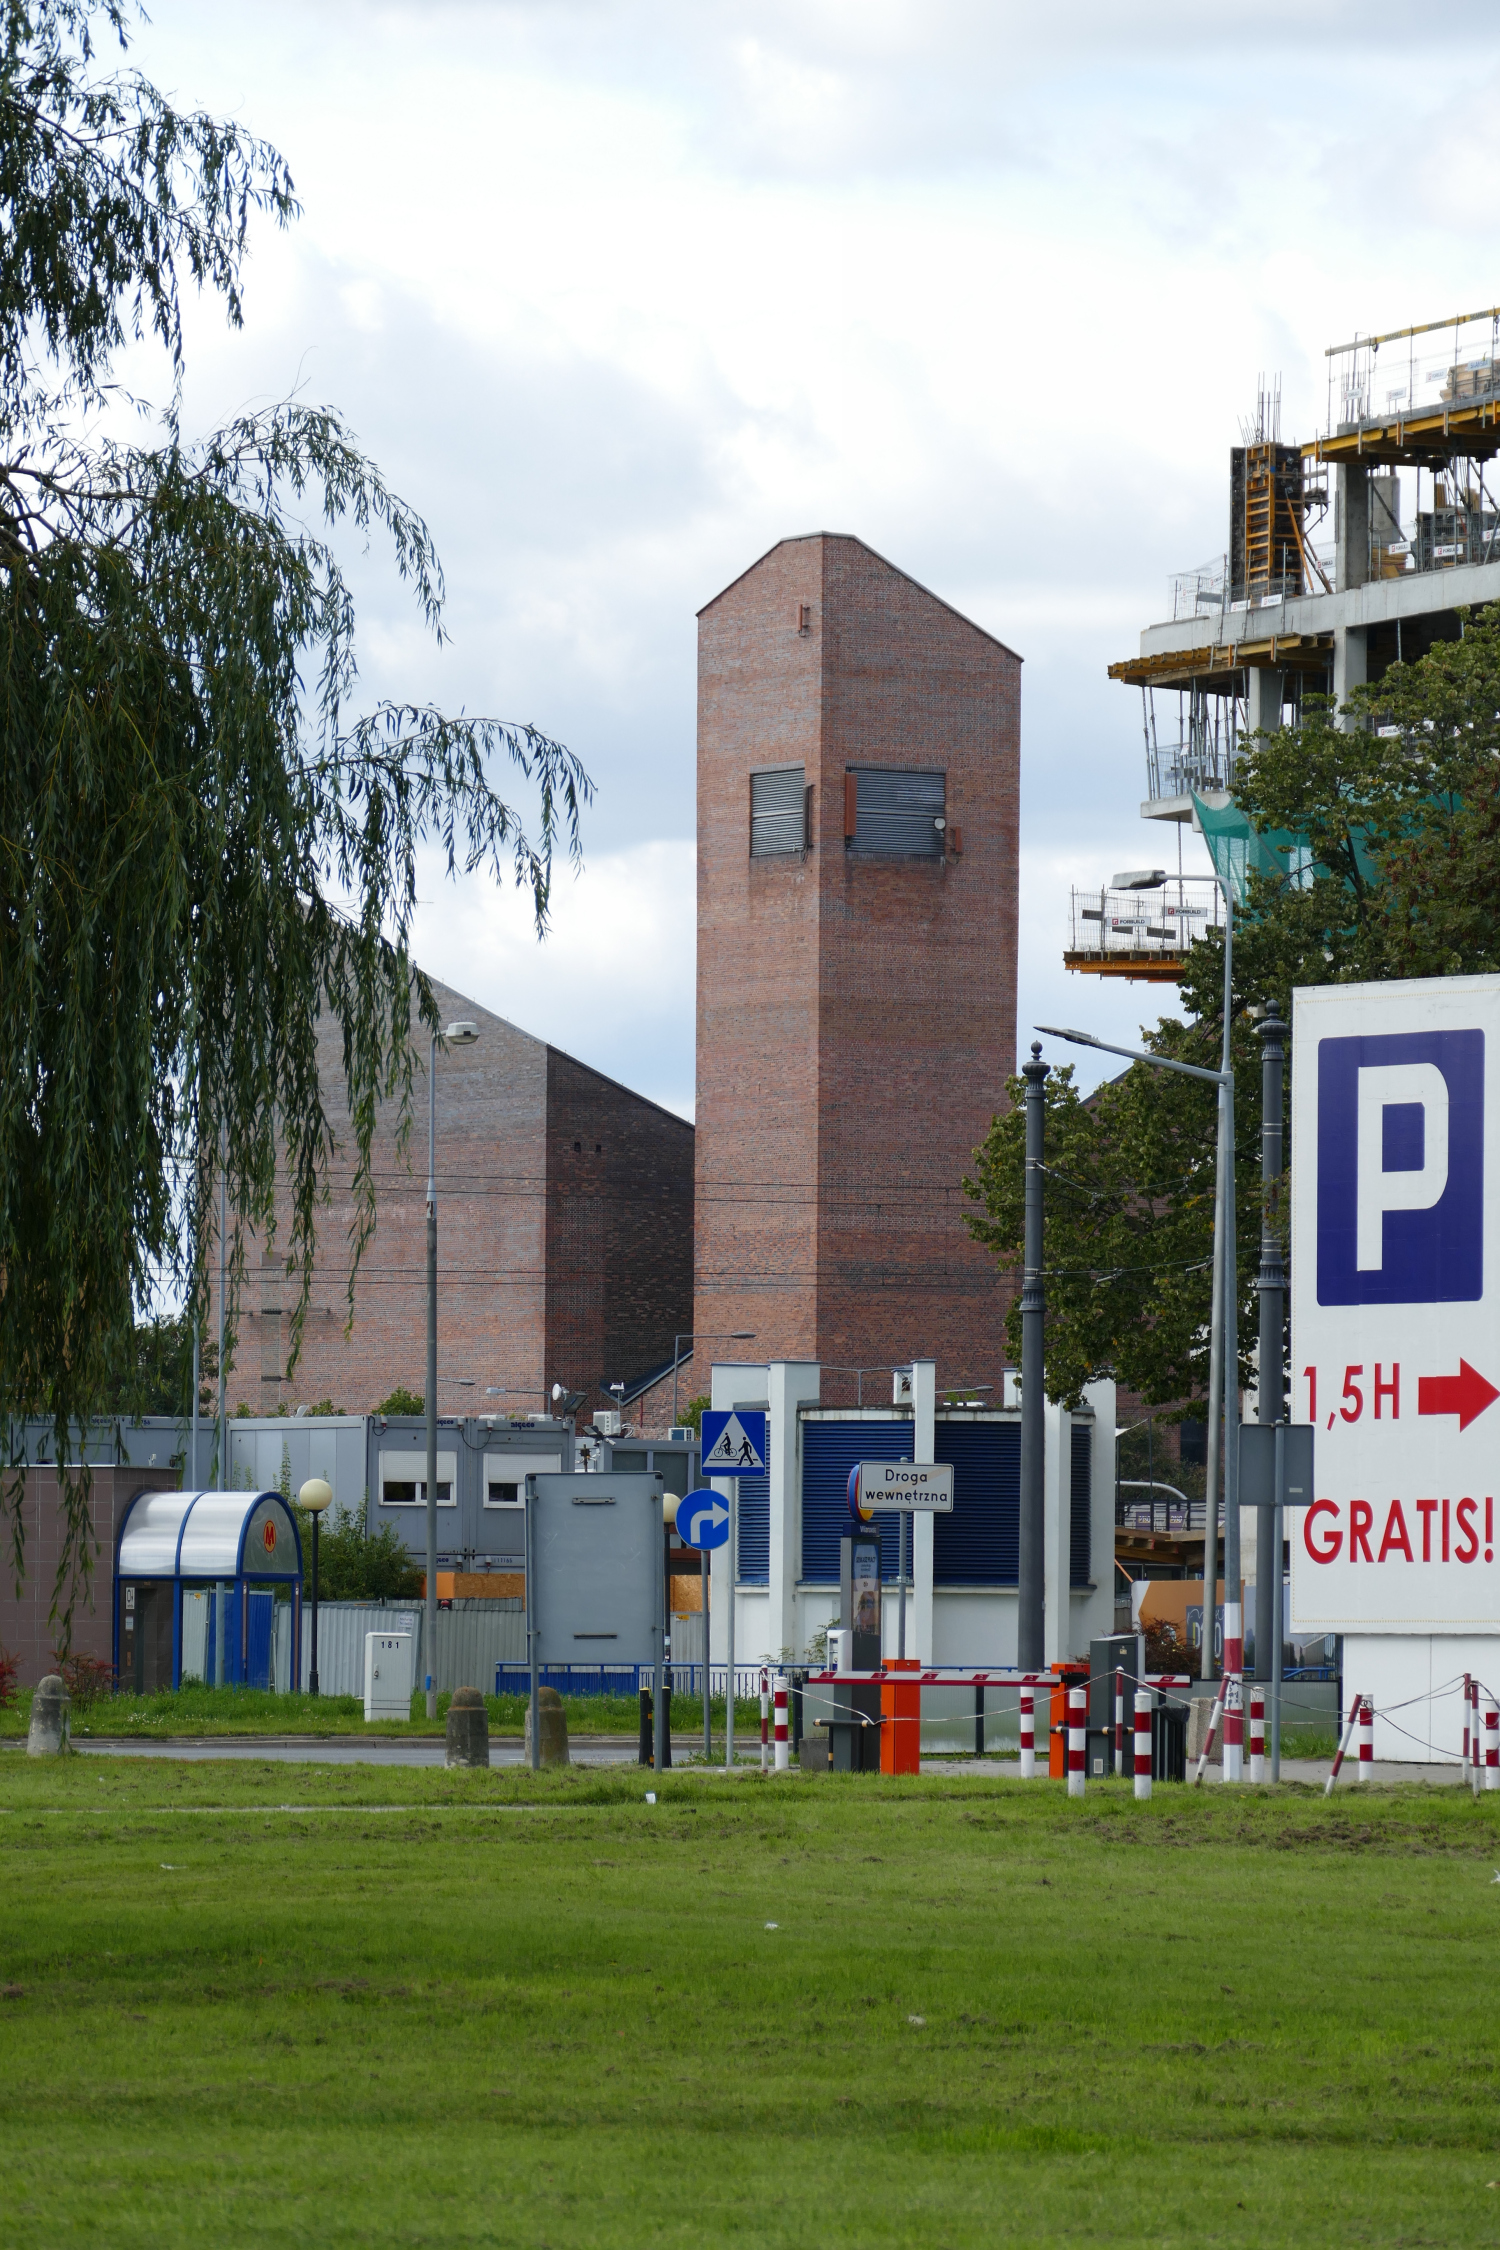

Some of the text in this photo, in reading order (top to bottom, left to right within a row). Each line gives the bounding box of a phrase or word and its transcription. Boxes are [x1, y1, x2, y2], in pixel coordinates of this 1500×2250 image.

[1357, 1062, 1449, 1272] P
[1303, 1362, 1400, 1431] 1,5H
[511, 1421, 535, 1430] algeco
[885, 1469, 928, 1486] Droga
[865, 1490, 948, 1504] wewnętrzna
[1303, 1496, 1494, 1565] GRATIS!
[381, 1640, 399, 1649] 181
